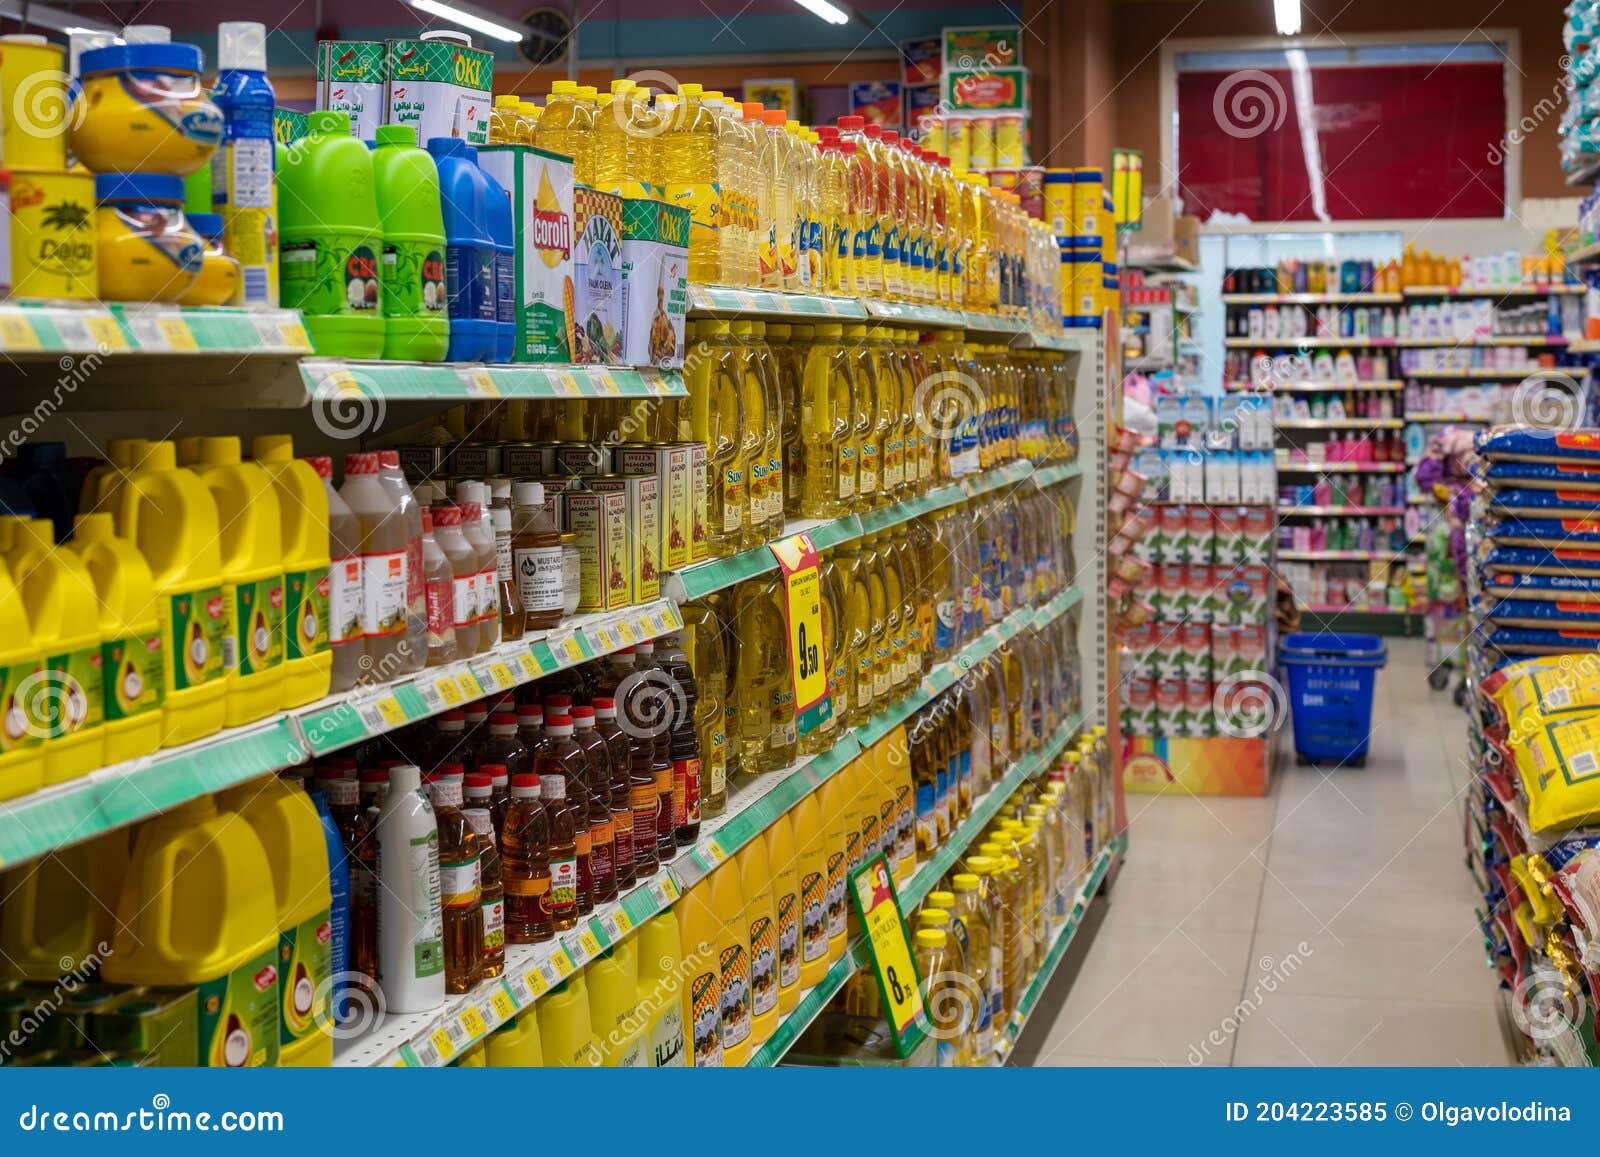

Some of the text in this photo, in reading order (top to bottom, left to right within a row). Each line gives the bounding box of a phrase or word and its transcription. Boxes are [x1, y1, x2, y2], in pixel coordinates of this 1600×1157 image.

[455, 55, 481, 86] OKI
[582, 217, 620, 260] HAYAT
[661, 211, 682, 244] OKI
[798, 622, 819, 681] 9.50
